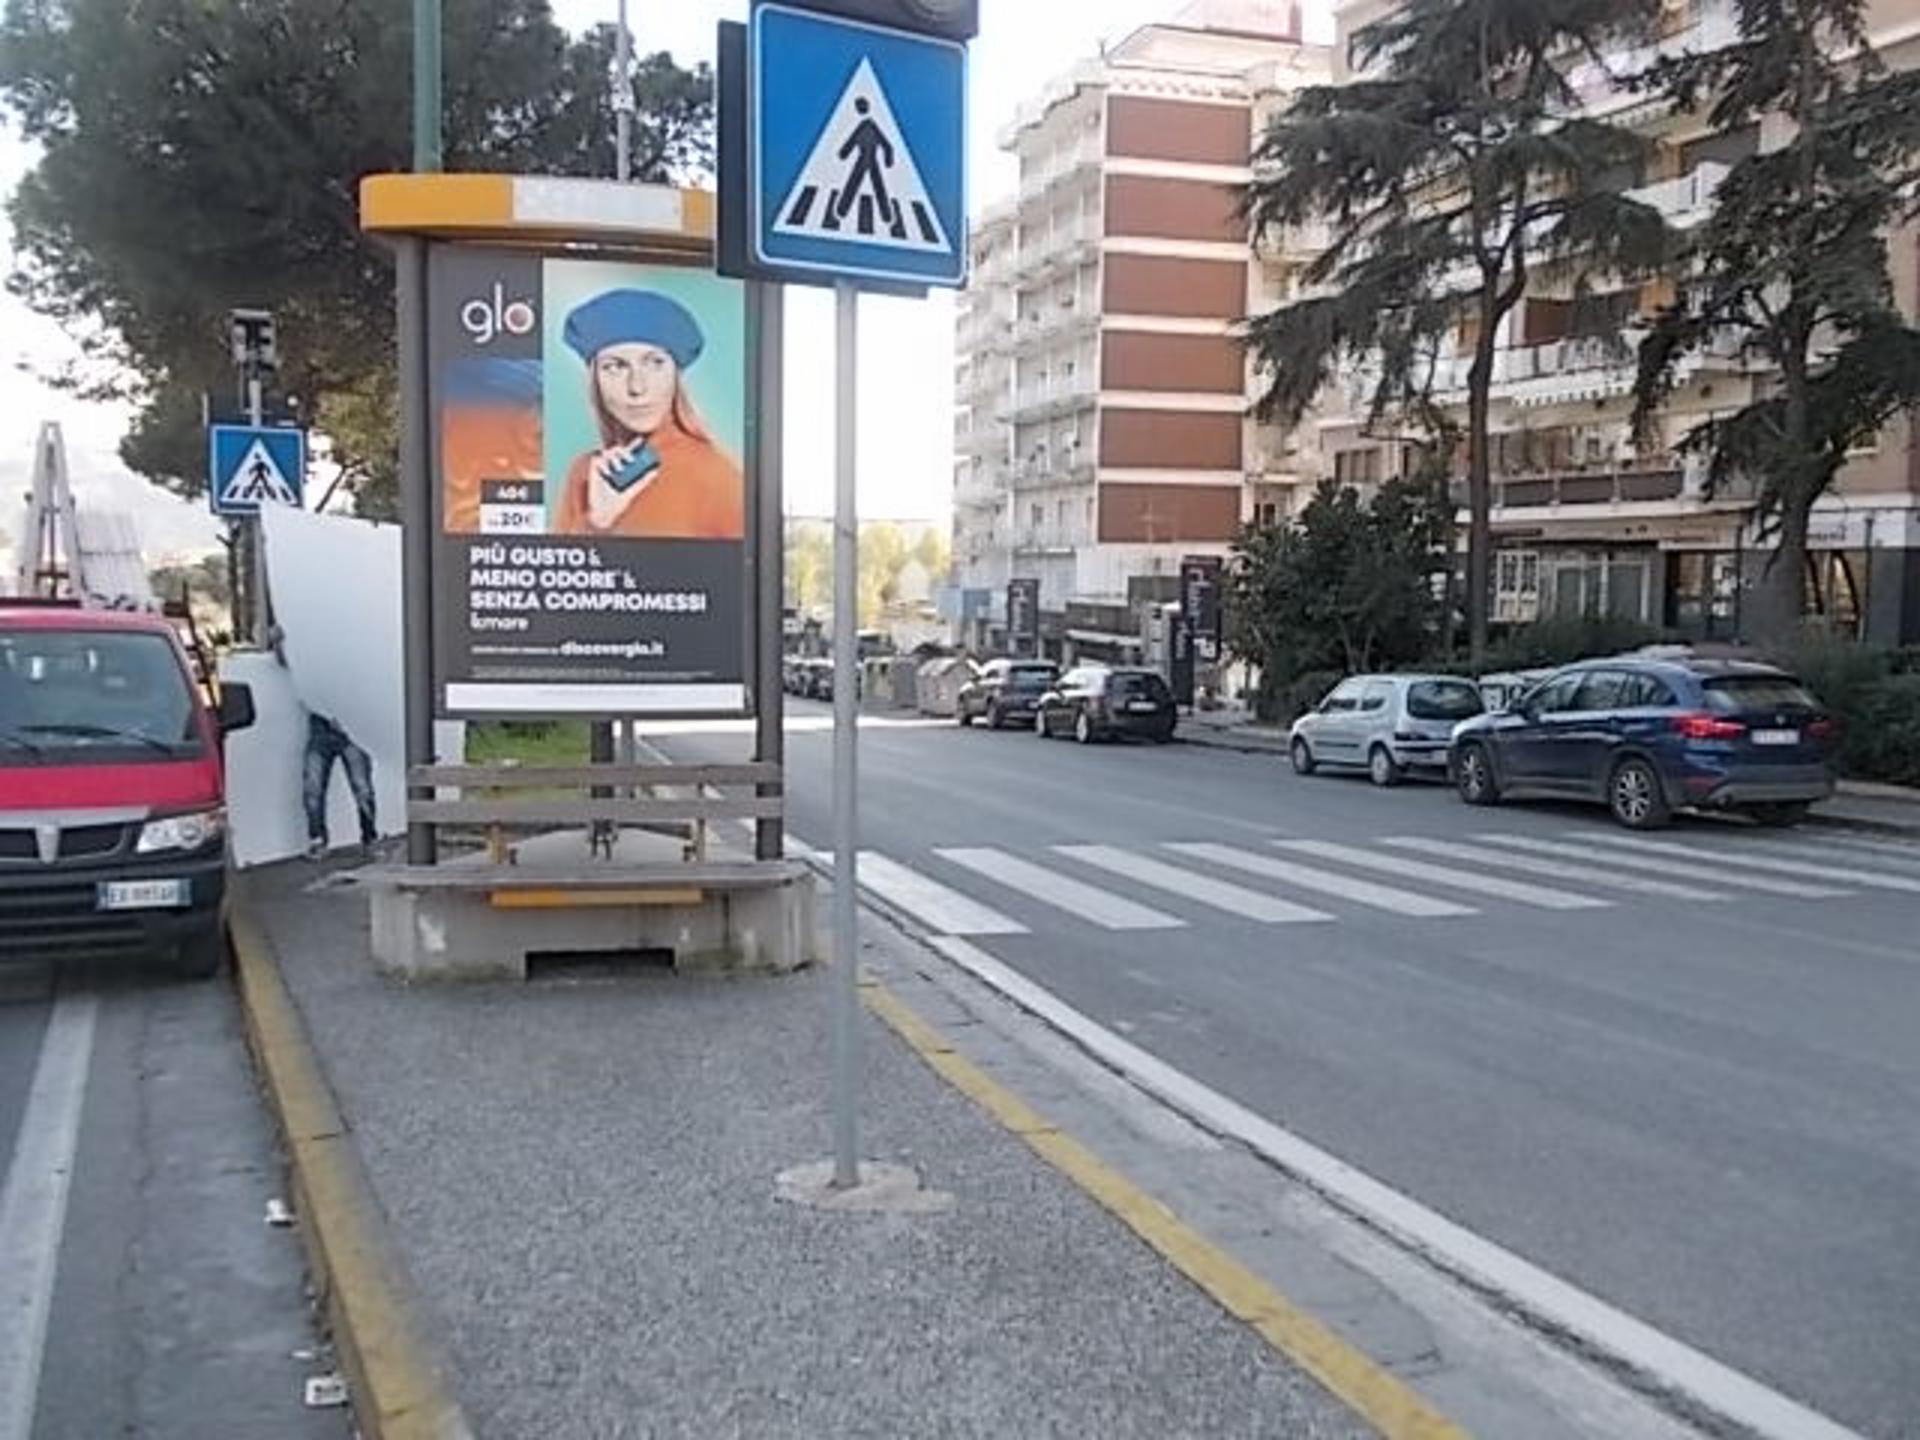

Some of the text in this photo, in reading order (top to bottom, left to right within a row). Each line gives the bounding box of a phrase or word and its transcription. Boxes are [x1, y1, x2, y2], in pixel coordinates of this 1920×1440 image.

[461, 281, 536, 343] glo
[470, 543, 506, 565] PIÙ
[510, 547, 586, 566] GUSTO
[470, 569, 536, 588] MENO
[470, 591, 707, 612] SENZA COMPROMESSI
